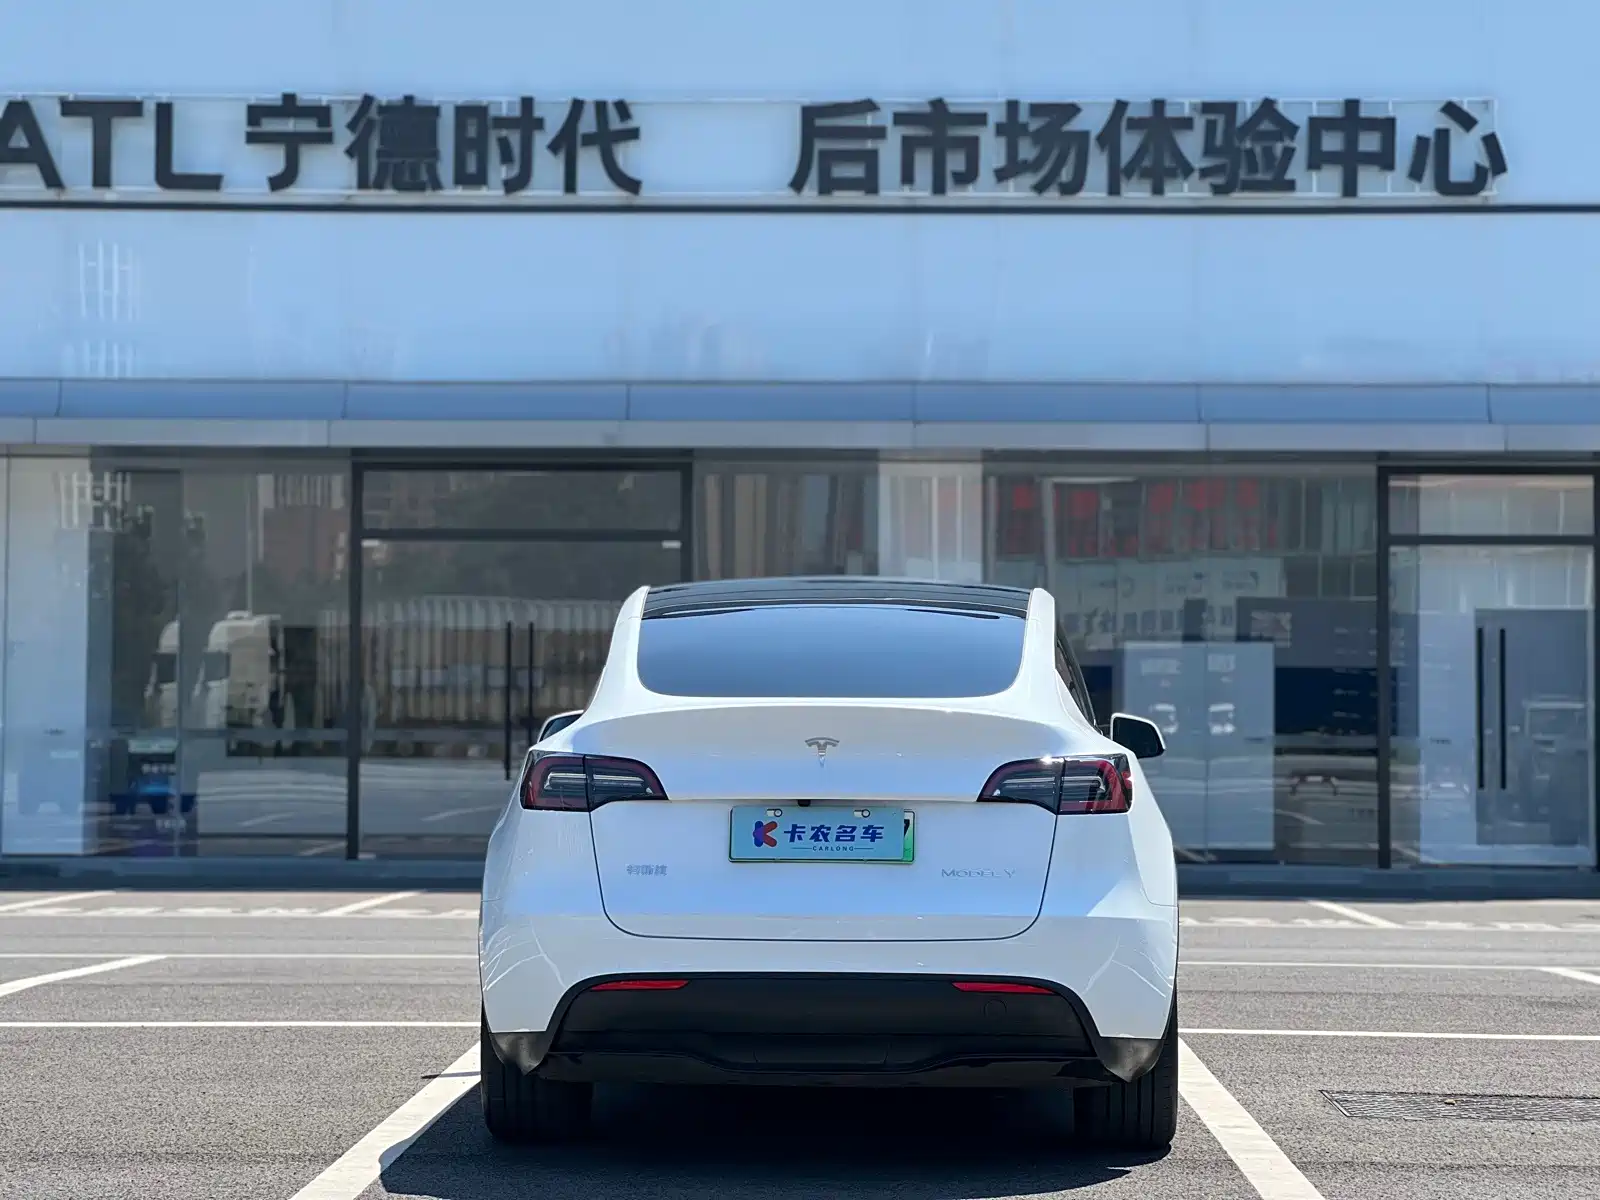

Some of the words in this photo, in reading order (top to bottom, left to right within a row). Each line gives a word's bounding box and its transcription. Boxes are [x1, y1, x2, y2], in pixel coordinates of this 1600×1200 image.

[246, 93, 642, 195] 宁德时代
[789, 97, 1507, 198] 后市场体验中心
[783, 824, 884, 843] 卡农名车
[1003, 868, 1016, 878] Y
